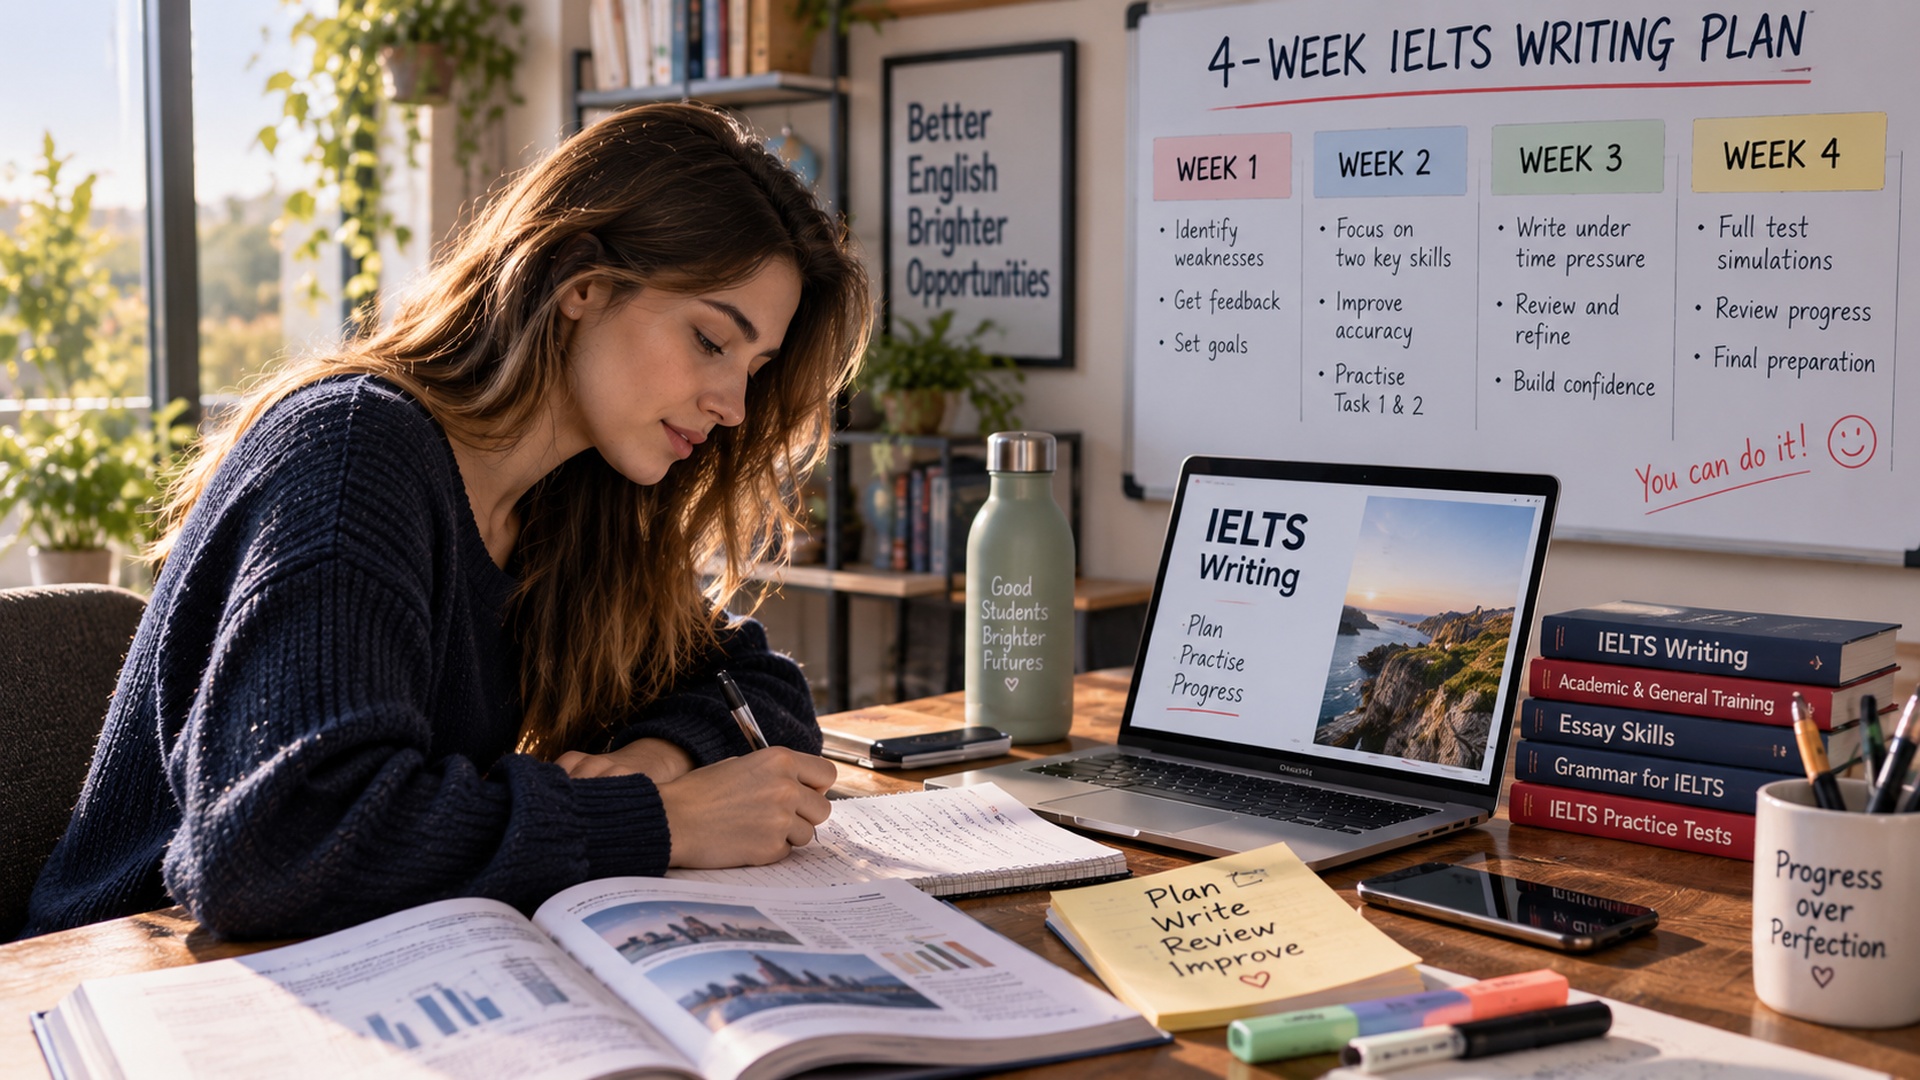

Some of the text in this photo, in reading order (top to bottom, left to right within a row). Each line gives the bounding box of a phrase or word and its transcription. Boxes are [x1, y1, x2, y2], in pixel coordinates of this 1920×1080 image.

[1207, 10, 1807, 89] 4-WEEK IELTS WRITING PLAN
[908, 102, 991, 143] Better
[1176, 154, 1257, 182] WEEK 1
[1338, 148, 1431, 178] WEEK 2
[1519, 143, 1623, 174] WEEK 3
[1723, 137, 1841, 171] WEEK 4
[908, 150, 998, 204] English
[908, 206, 1008, 258] Brighter
[1176, 217, 1238, 248] Identify
[1337, 216, 1414, 239] Focus on
[1516, 215, 1632, 238] Write under
[1719, 213, 1809, 239] Full test
[1174, 247, 1264, 267] weaknesses
[1335, 245, 1452, 277] two key skills
[1515, 247, 1646, 277] time pressure
[1717, 247, 1833, 271] simulations
[906, 257, 1050, 307] Opportunities
[1174, 288, 1281, 315] Get feedback
[1337, 291, 1403, 320] Improve
[1516, 293, 1620, 316] Review and
[1716, 297, 1872, 331] Review progress
[1174, 332, 1248, 362] Set goals
[1335, 325, 1413, 350] accuracy
[1516, 321, 1571, 349] refine
[1335, 363, 1405, 386] Practise
[1714, 344, 1875, 379] Final preparation
[1514, 370, 1656, 401] Build confidence
[1333, 391, 1424, 416] Task 1 & 2
[1634, 422, 1807, 503] You can do it!
[1205, 507, 1309, 551] IELTS
[990, 575, 1033, 597] Good
[1200, 552, 1301, 598] Writing
[981, 600, 1049, 621] Students
[982, 625, 1046, 653] Brighter
[1187, 613, 1223, 639] Plan
[983, 650, 1044, 671] Futures
[1179, 644, 1245, 673] Practise
[1598, 631, 1657, 657] IELTS
[1664, 637, 1749, 671] Writing
[1171, 672, 1244, 707] Progress
[1558, 673, 1629, 697] Academic
[1632, 681, 1644, 698] &
[1648, 683, 1708, 705] General
[1711, 689, 1775, 716] Training
[1559, 713, 1616, 744] Essay
[1622, 721, 1675, 747] Skills
[1554, 756, 1638, 785] Grammar
[1642, 767, 1670, 790] for
[1674, 773, 1724, 798] IELTS
[1550, 799, 1598, 824] IELTS
[1603, 807, 1678, 837] Practice
[1683, 819, 1732, 846] Tests
[1776, 849, 1884, 896] Progress
[1144, 882, 1221, 909] Plan
[1795, 896, 1855, 922] over
[1150, 902, 1250, 932] Write
[1160, 922, 1276, 956] Review
[1771, 917, 1887, 959] Perfection
[1168, 943, 1304, 977] Improve
